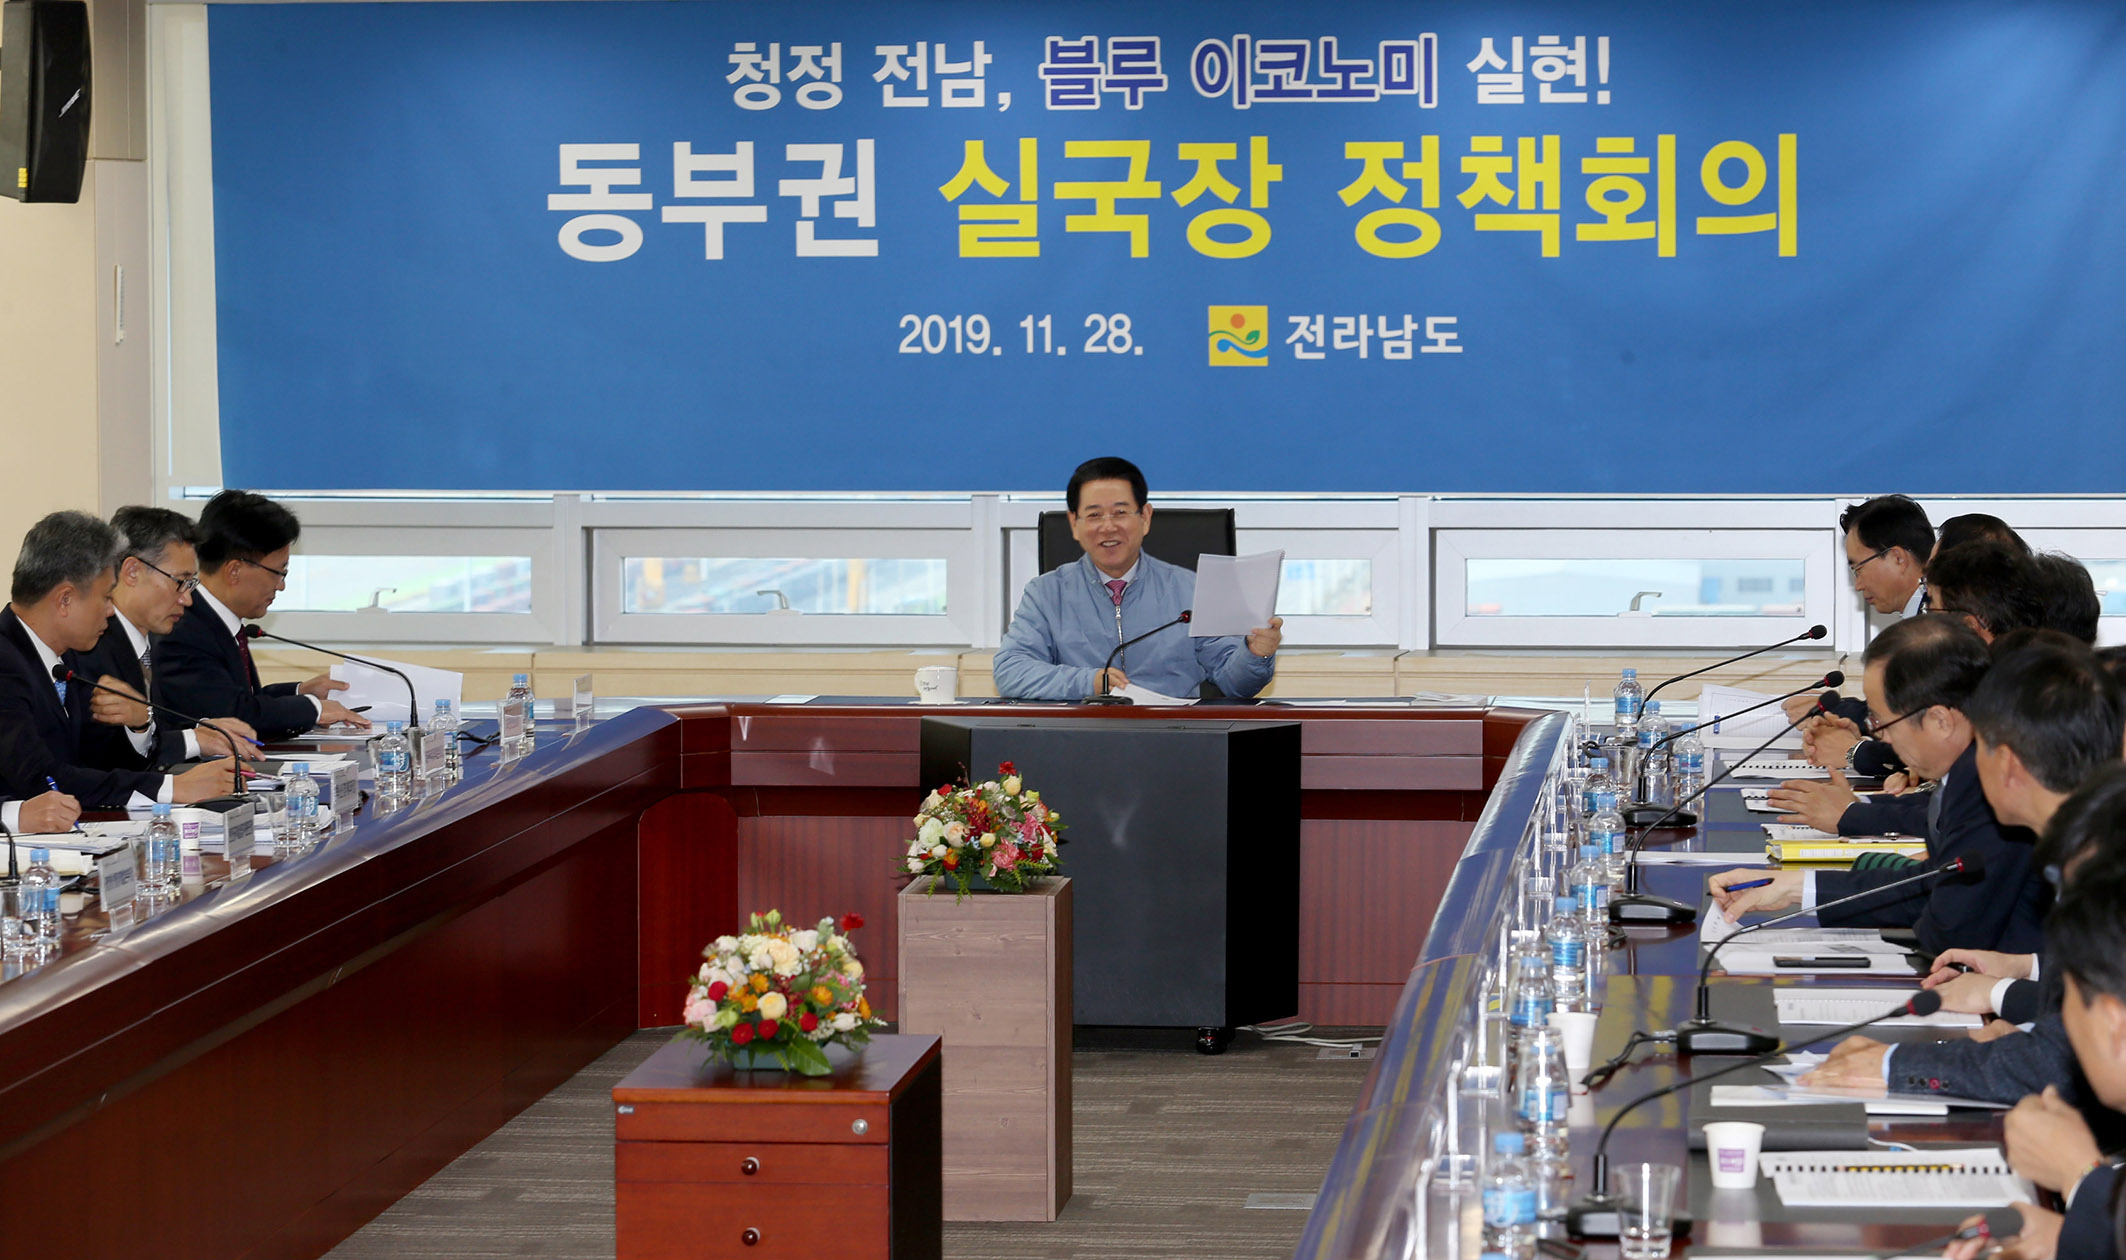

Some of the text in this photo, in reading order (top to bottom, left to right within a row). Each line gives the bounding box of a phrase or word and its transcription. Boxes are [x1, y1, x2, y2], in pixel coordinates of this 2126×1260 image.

[726, 32, 1610, 111] 청정 전남, 블루 이코노미 실현!
[548, 134, 1797, 262] 동부권 실국장 정책회의
[899, 313, 1143, 356] 2019. 11. 28.
[1286, 314, 1463, 360] 전라남도
